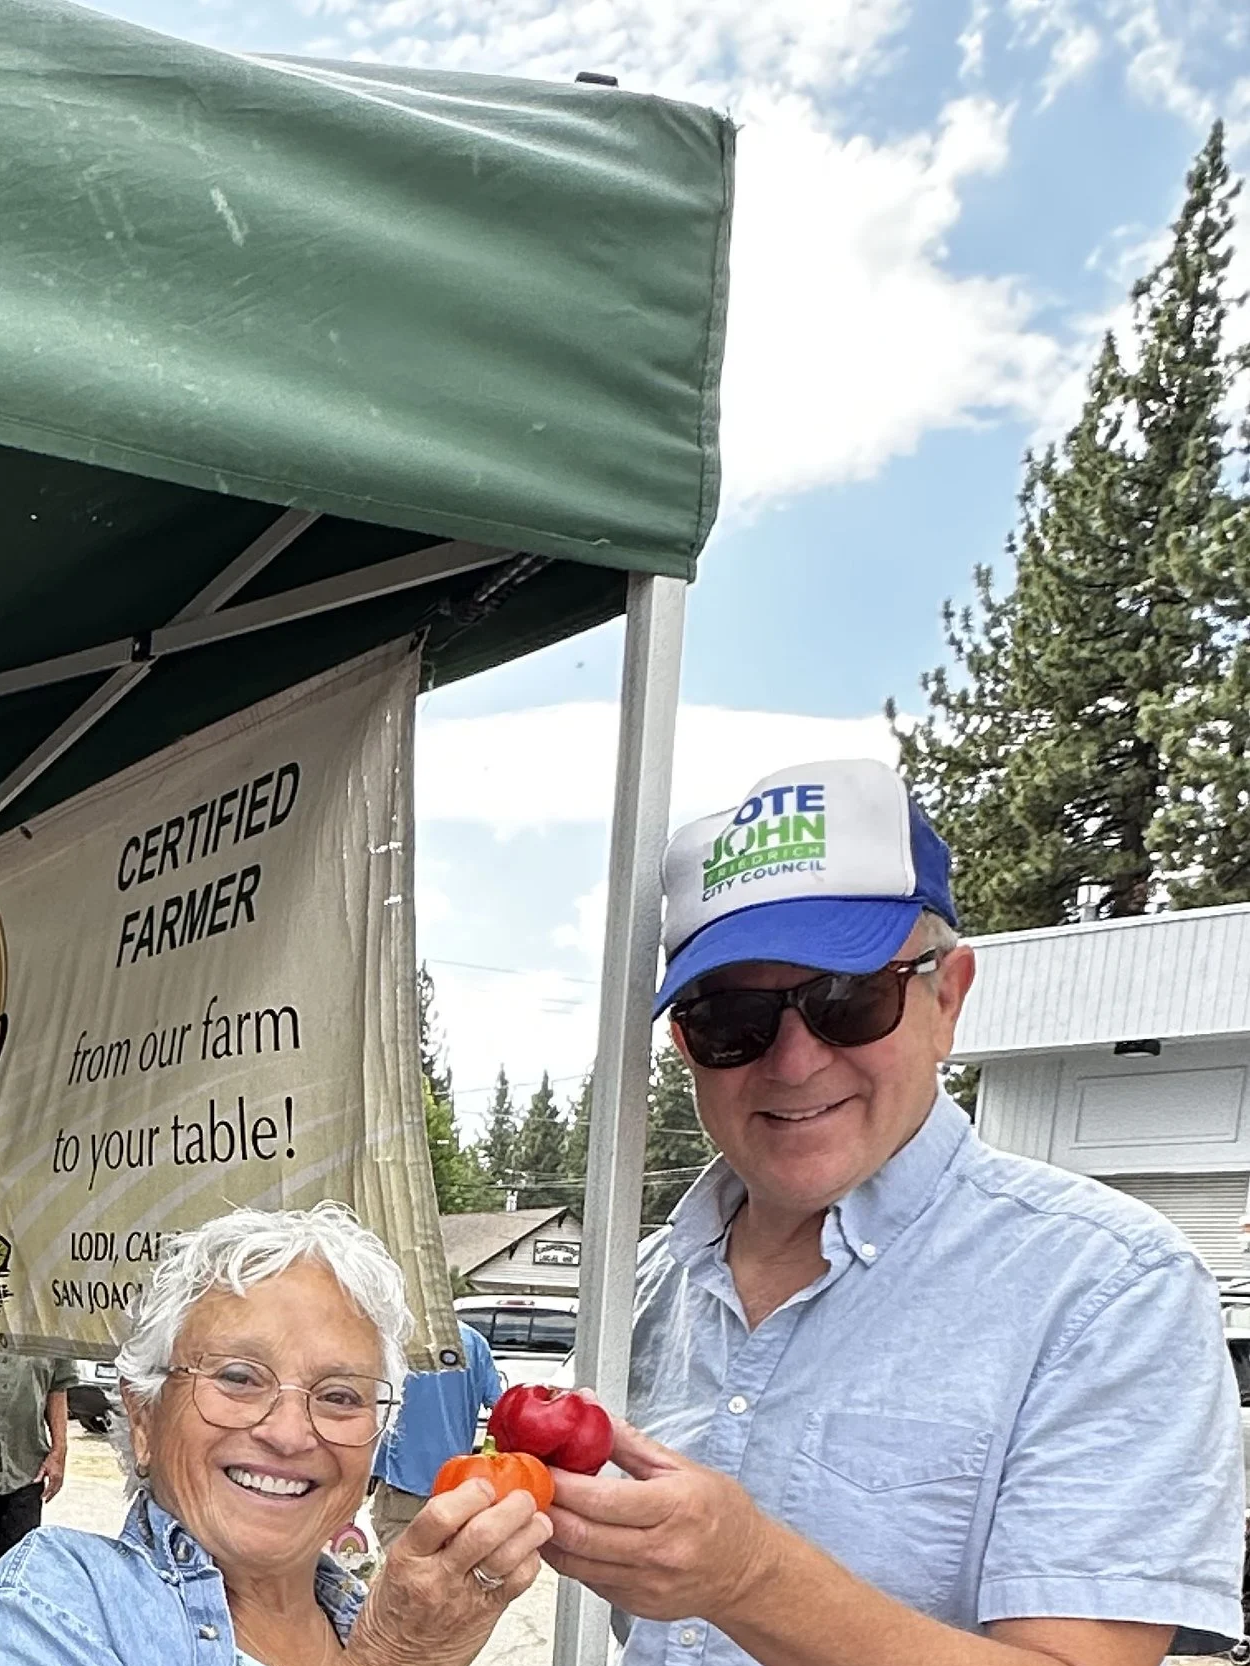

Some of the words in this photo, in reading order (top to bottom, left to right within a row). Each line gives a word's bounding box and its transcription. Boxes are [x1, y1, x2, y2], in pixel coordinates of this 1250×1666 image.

[117, 762, 300, 892] CERTIFIED
[733, 784, 825, 826] OTE
[702, 813, 826, 869] JOHN
[702, 876, 735, 902] CITY
[741, 860, 826, 883] COUNCIL
[115, 863, 261, 969] FARMER
[67, 1030, 131, 1085] from
[139, 1023, 192, 1072] our
[201, 995, 301, 1061] farm
[53, 1128, 81, 1174] to
[88, 1126, 160, 1191] your
[171, 1096, 295, 1166] table!
[71, 1231, 119, 1268] LODI,
[51, 1278, 84, 1309] SAN
